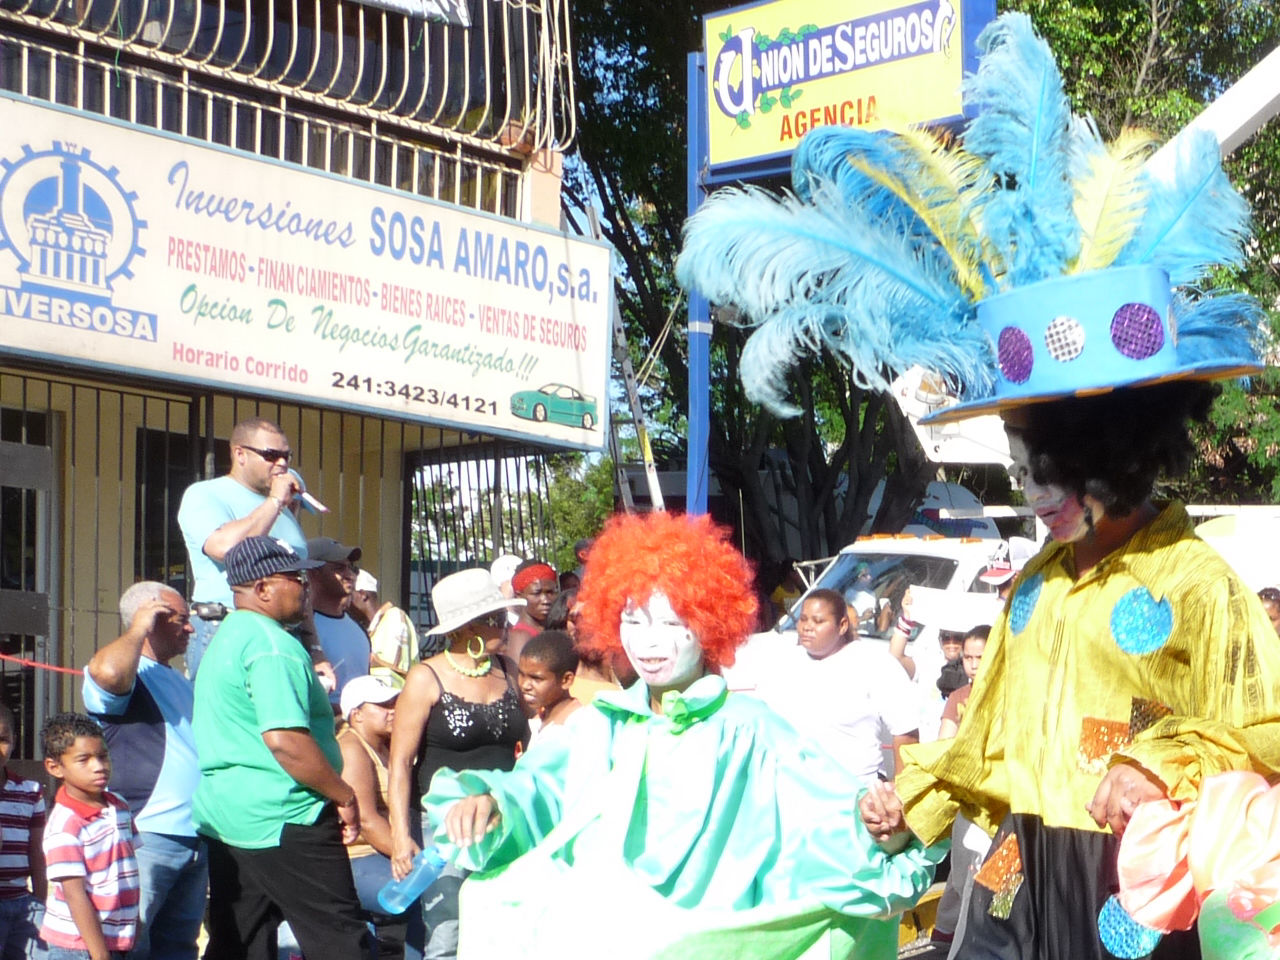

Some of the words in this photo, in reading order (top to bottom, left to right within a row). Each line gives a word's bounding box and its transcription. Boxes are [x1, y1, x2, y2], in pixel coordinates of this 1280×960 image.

[713, 26, 806, 116] UNION
[809, 34, 834, 77] DE
[834, 8, 935, 72] SEGUROS
[780, 96, 879, 142] AGENCIA
[167, 160, 356, 249] Inversiones
[369, 206, 445, 270] SOSA
[0, 287, 155, 342] VERSOSA
[167, 235, 246, 284] PRESTAMOS
[381, 282, 422, 320] BIENES
[426, 292, 466, 328] RAICES
[478, 303, 520, 340] VENTAS
[523, 313, 536, 343] DE
[539, 317, 587, 353] SEGUROS
[180, 282, 254, 327] Opcion
[267, 298, 296, 334] De
[311, 304, 400, 353] Negocios
[172, 341, 240, 372] Horario
[245, 355, 309, 384] Corrido
[331, 371, 498, 416] 241:3423/4121
